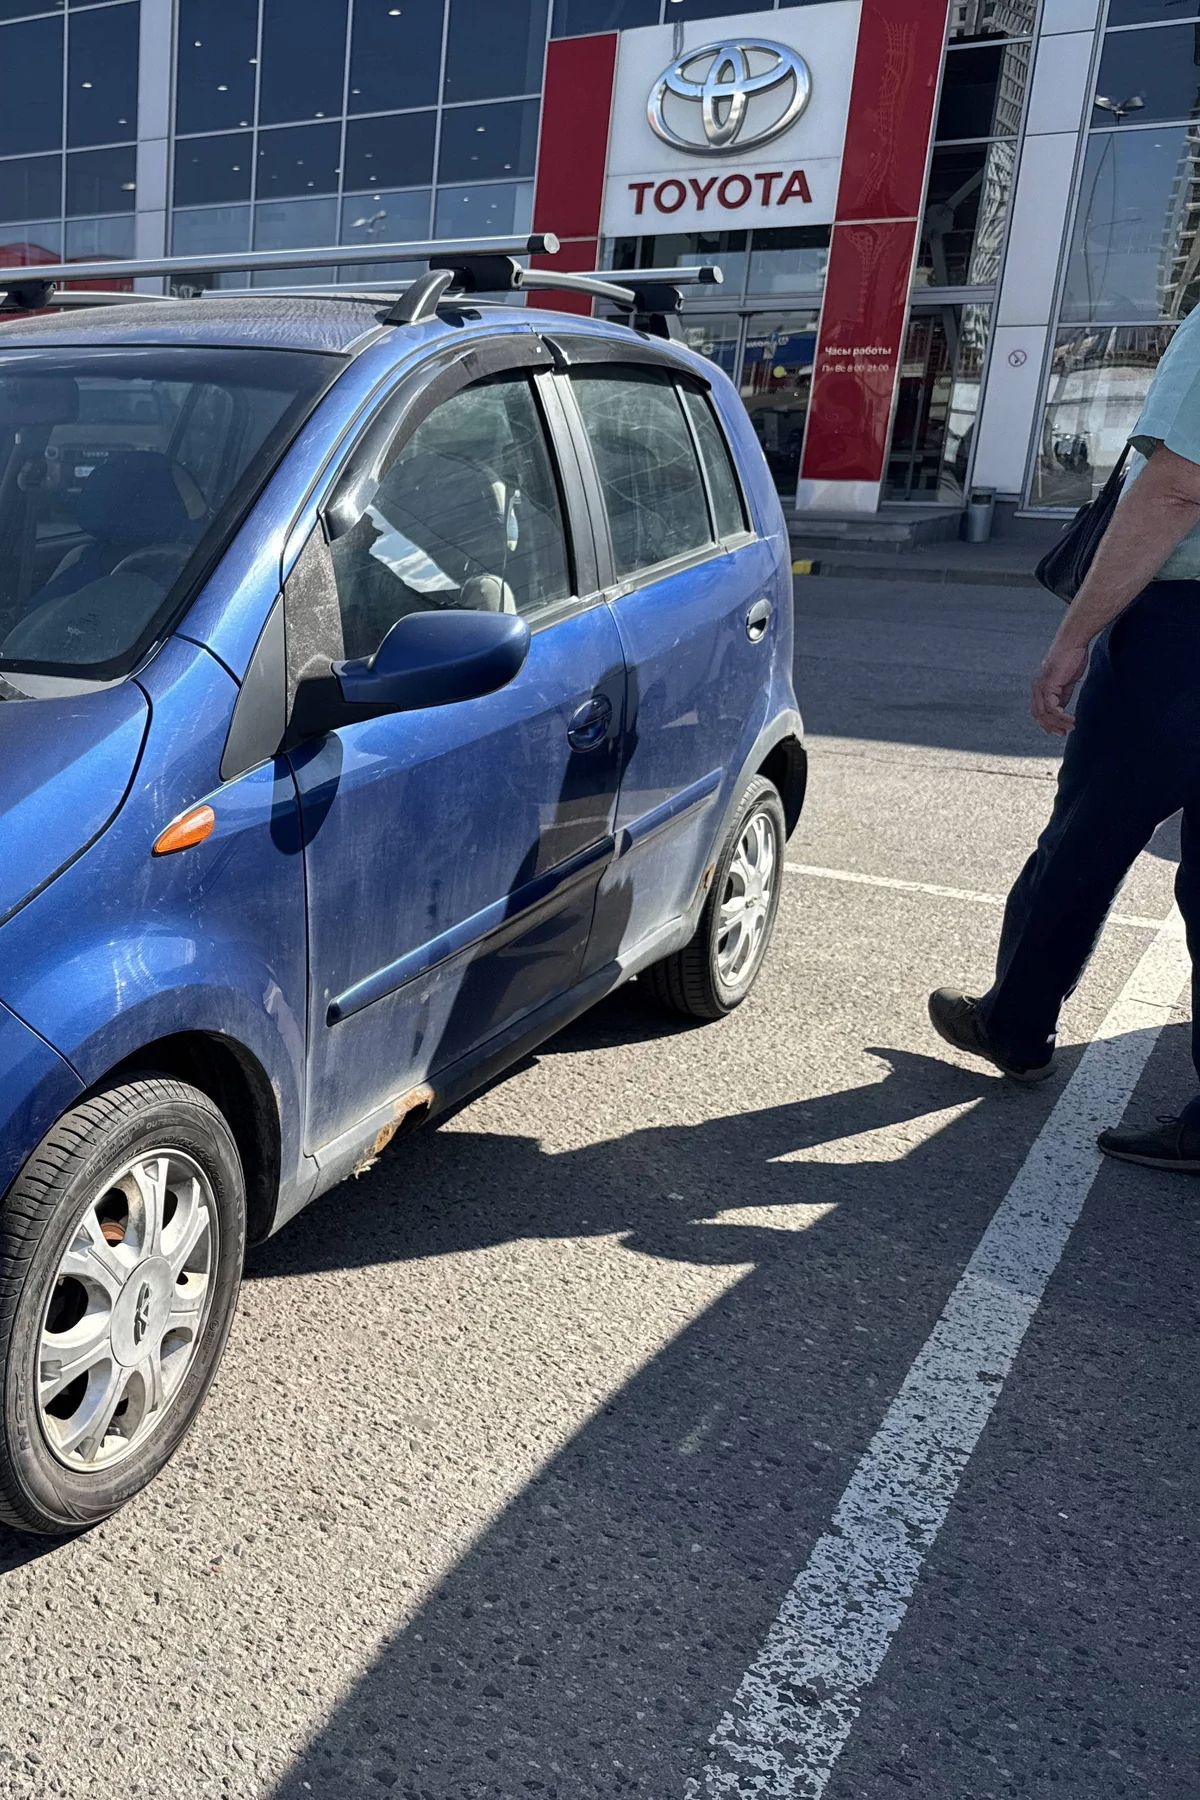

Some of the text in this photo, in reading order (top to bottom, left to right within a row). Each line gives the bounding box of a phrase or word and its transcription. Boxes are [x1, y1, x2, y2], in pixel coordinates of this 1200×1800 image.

[628, 169, 813, 215] TOYOTA
[825, 345, 892, 357] Часы работы
